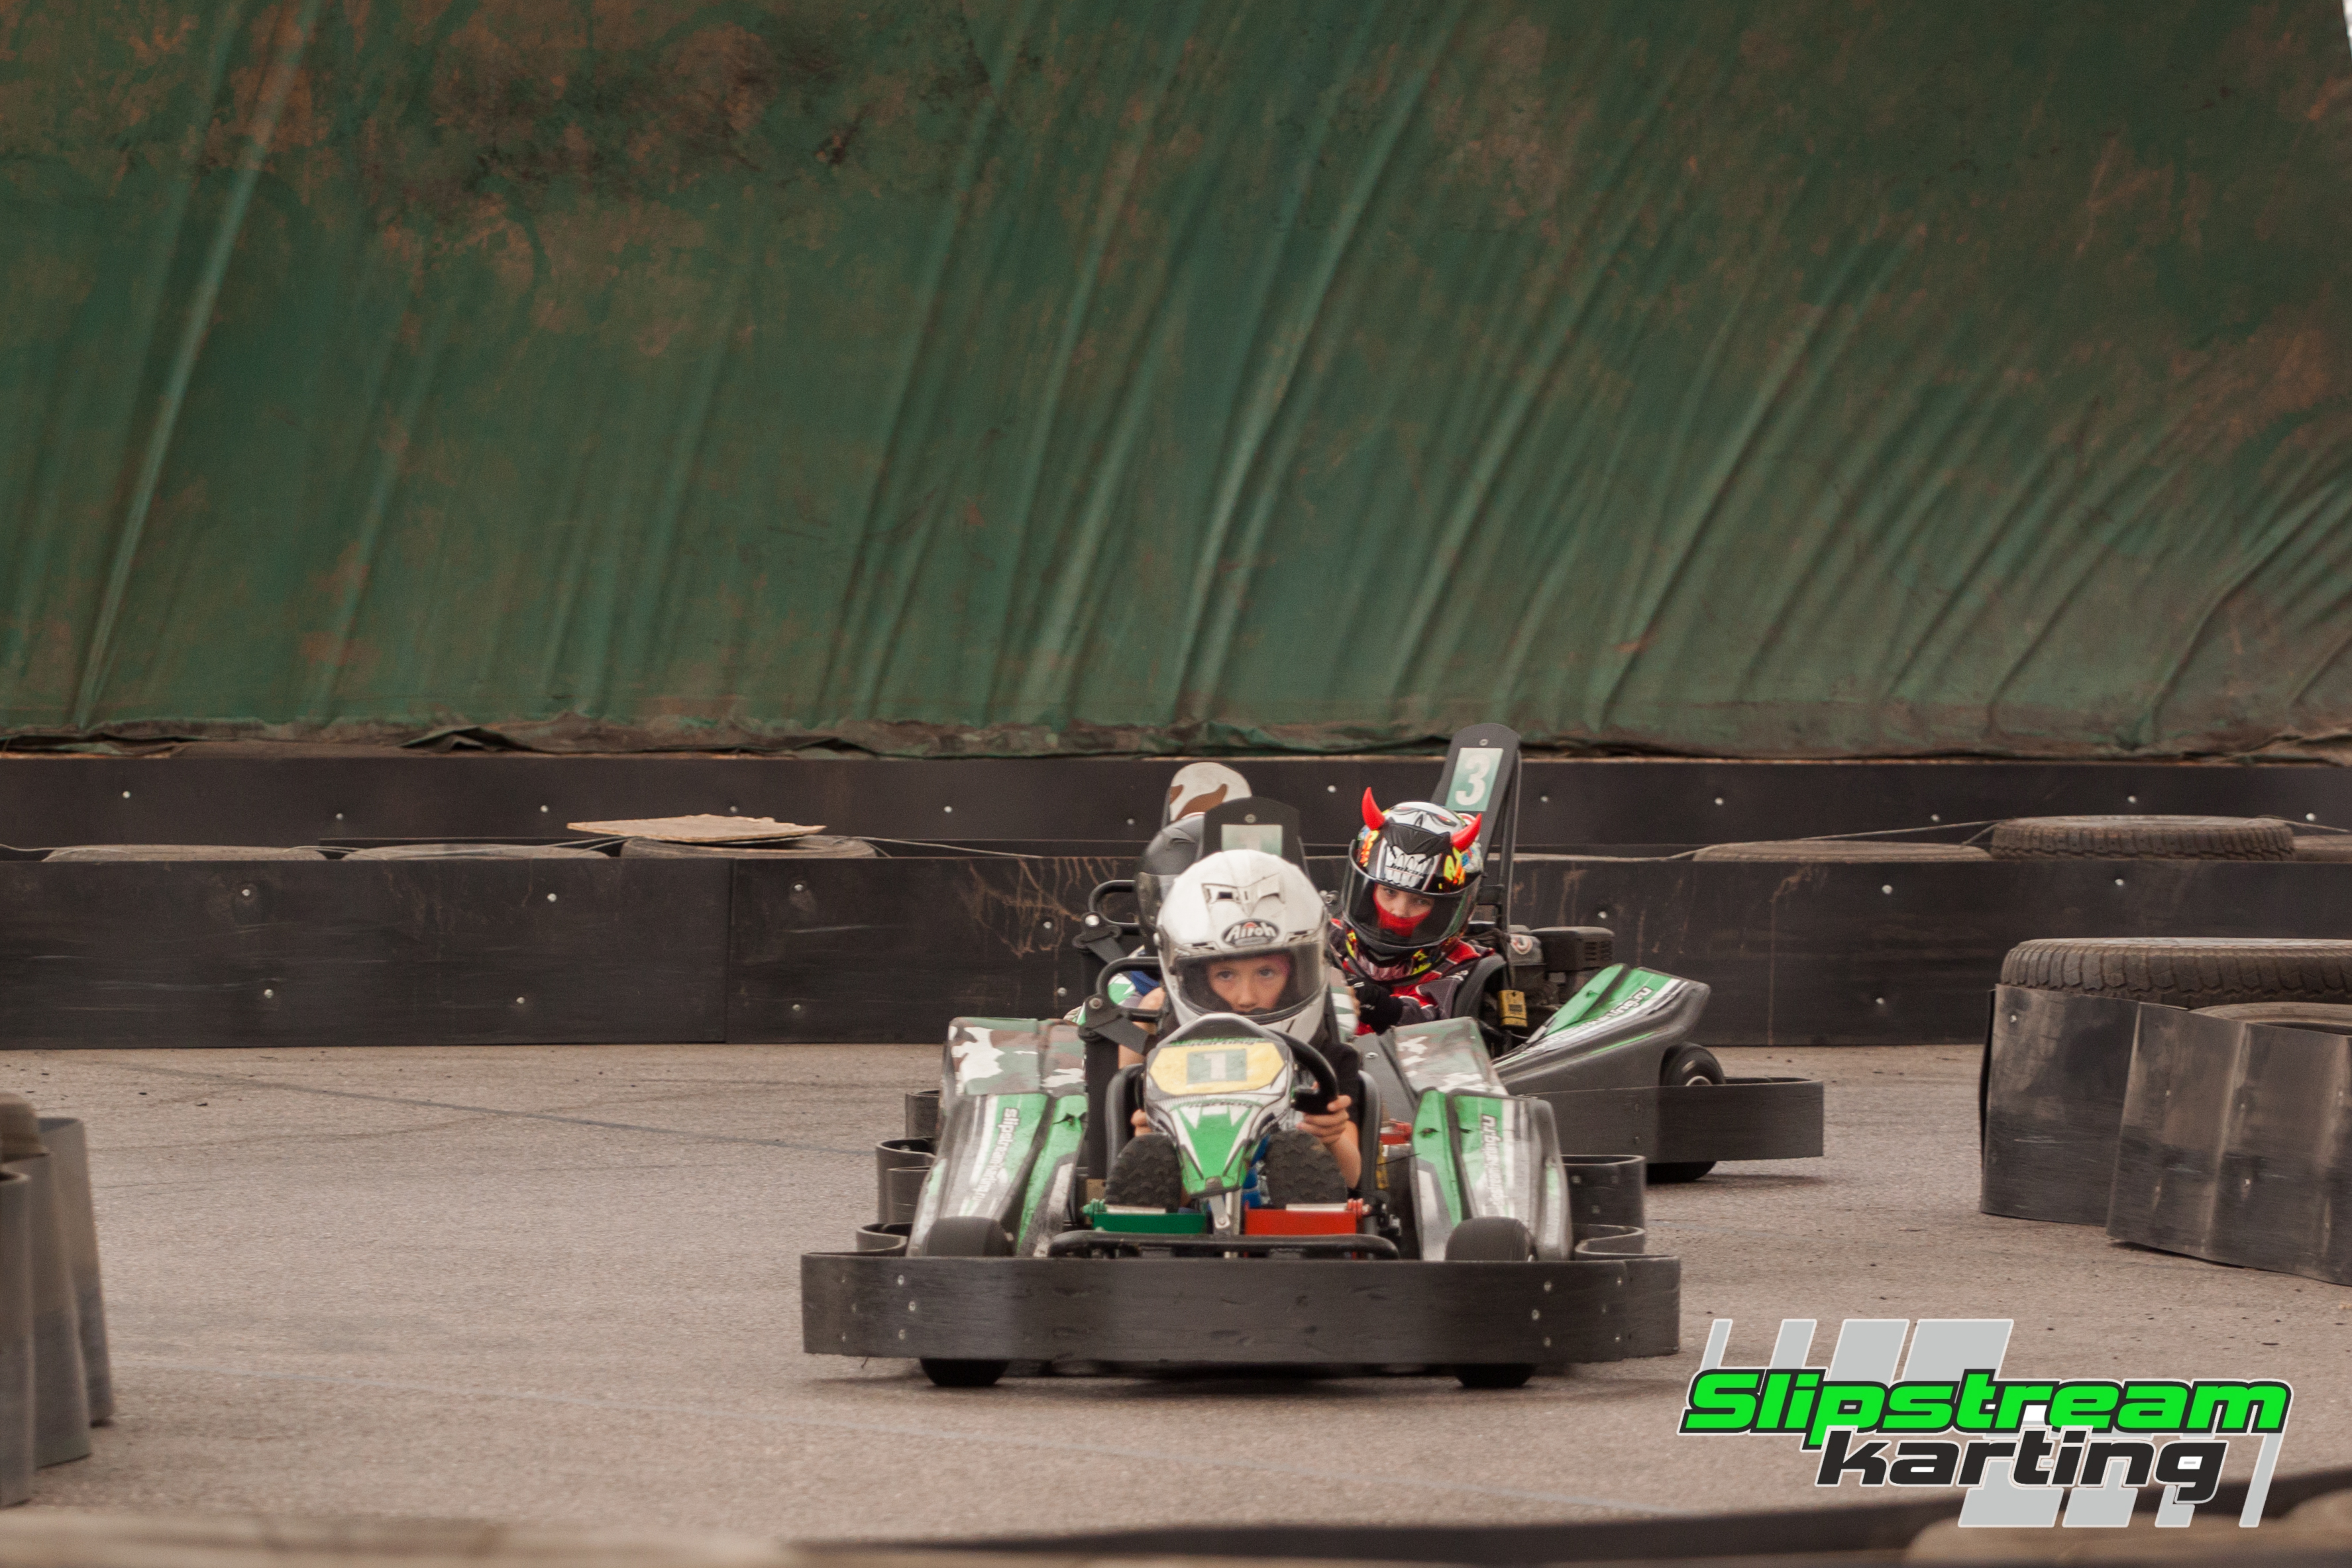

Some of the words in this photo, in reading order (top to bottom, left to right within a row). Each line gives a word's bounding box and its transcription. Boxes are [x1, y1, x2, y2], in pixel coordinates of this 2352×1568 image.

[1455, 754, 1491, 806] 3
[1225, 919, 1277, 942] Airoh
[1204, 1052, 1226, 1079] 1
